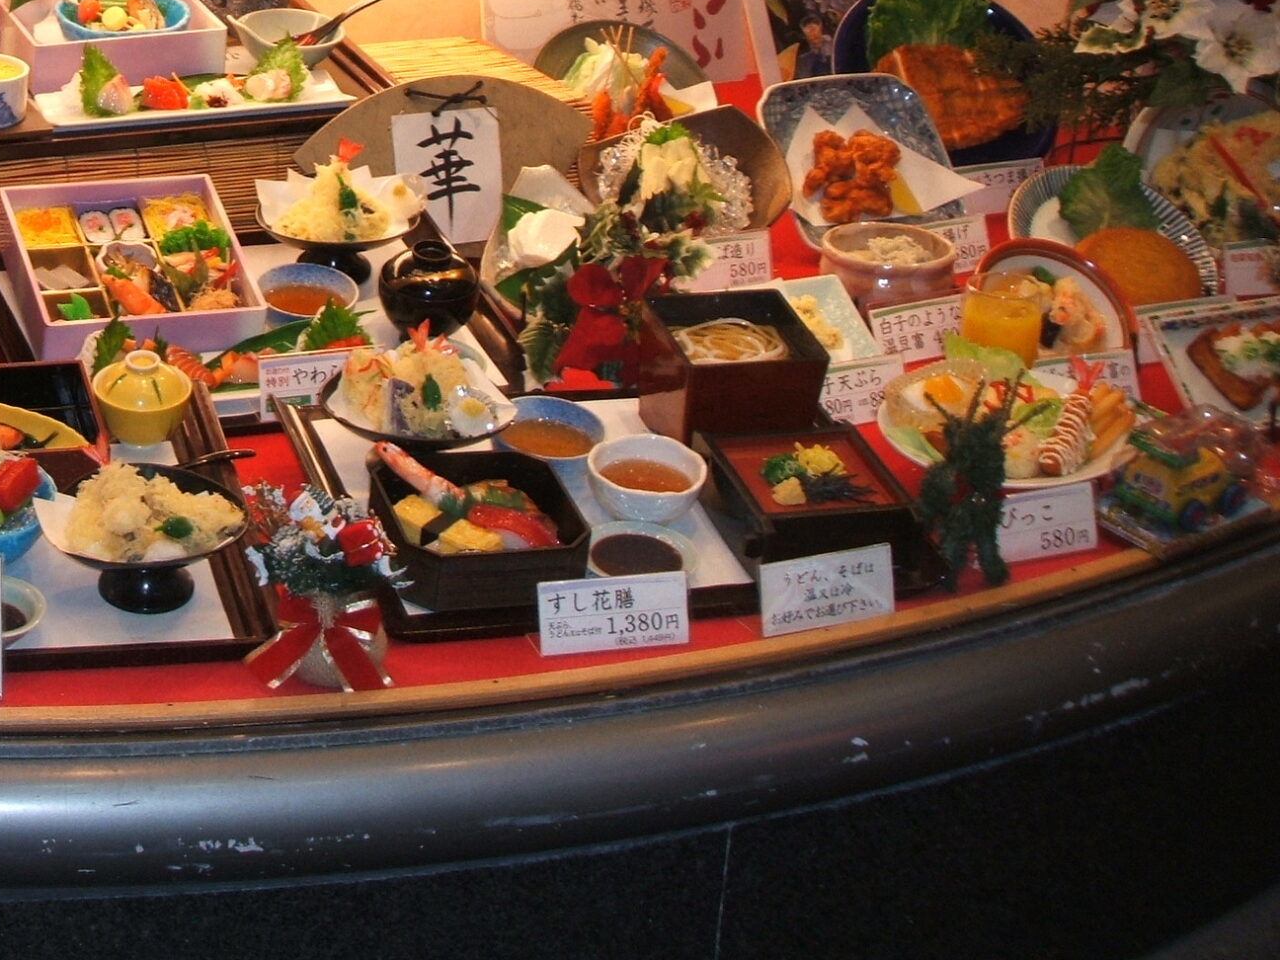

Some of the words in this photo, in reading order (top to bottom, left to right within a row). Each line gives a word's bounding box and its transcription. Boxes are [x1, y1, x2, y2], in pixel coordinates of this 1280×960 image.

[417, 117, 481, 233] 華
[730, 261, 768, 278] 580円
[1040, 526, 1090, 550] 580円
[547, 587, 636, 615] すし花膳
[606, 611, 681, 636] 1,380円
